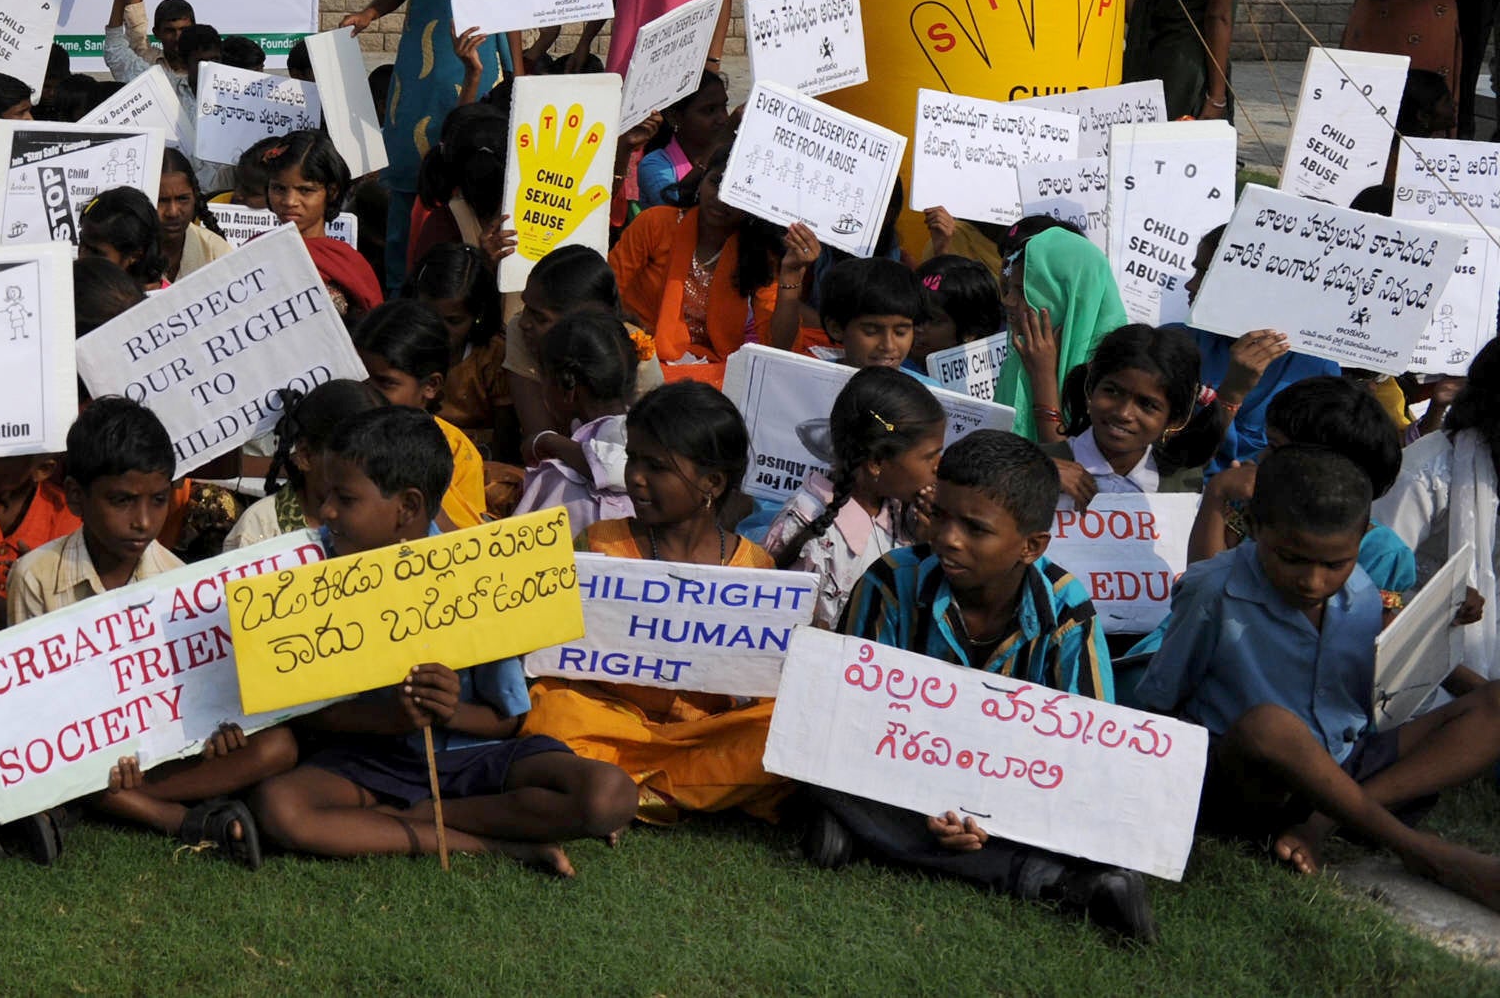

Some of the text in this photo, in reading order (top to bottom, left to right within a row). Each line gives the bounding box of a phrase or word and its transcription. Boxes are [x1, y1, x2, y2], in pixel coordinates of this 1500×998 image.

[756, 92, 787, 119] EVERY
[813, 117, 859, 149] DESERVES
[859, 138, 867, 154] A
[869, 142, 888, 162] LIFE
[1321, 124, 1356, 150] CHILD
[774, 126, 857, 175] FREE FROM ABUSE
[1306, 137, 1349, 170] SEXUAL
[537, 169, 574, 189] CHILD
[1300, 156, 1339, 185] ABUSE
[42, 168, 71, 242] STOP
[525, 188, 573, 212] SEXUAL
[523, 210, 565, 231] ABUSE
[1143, 218, 1189, 246] CHILD
[1129, 236, 1187, 271] SEXUAL
[1125, 260, 1178, 291] ABUSE
[122, 268, 266, 362] RESPECT
[125, 286, 324, 404] OUR RIGHT
[191, 372, 236, 407] TO
[1055, 510, 1160, 540] POOR
[678, 580, 811, 610] RIGHT
[1088, 571, 1182, 601] EDU
[628, 615, 792, 651] HUMAN
[558, 647, 691, 682] RIGHT
